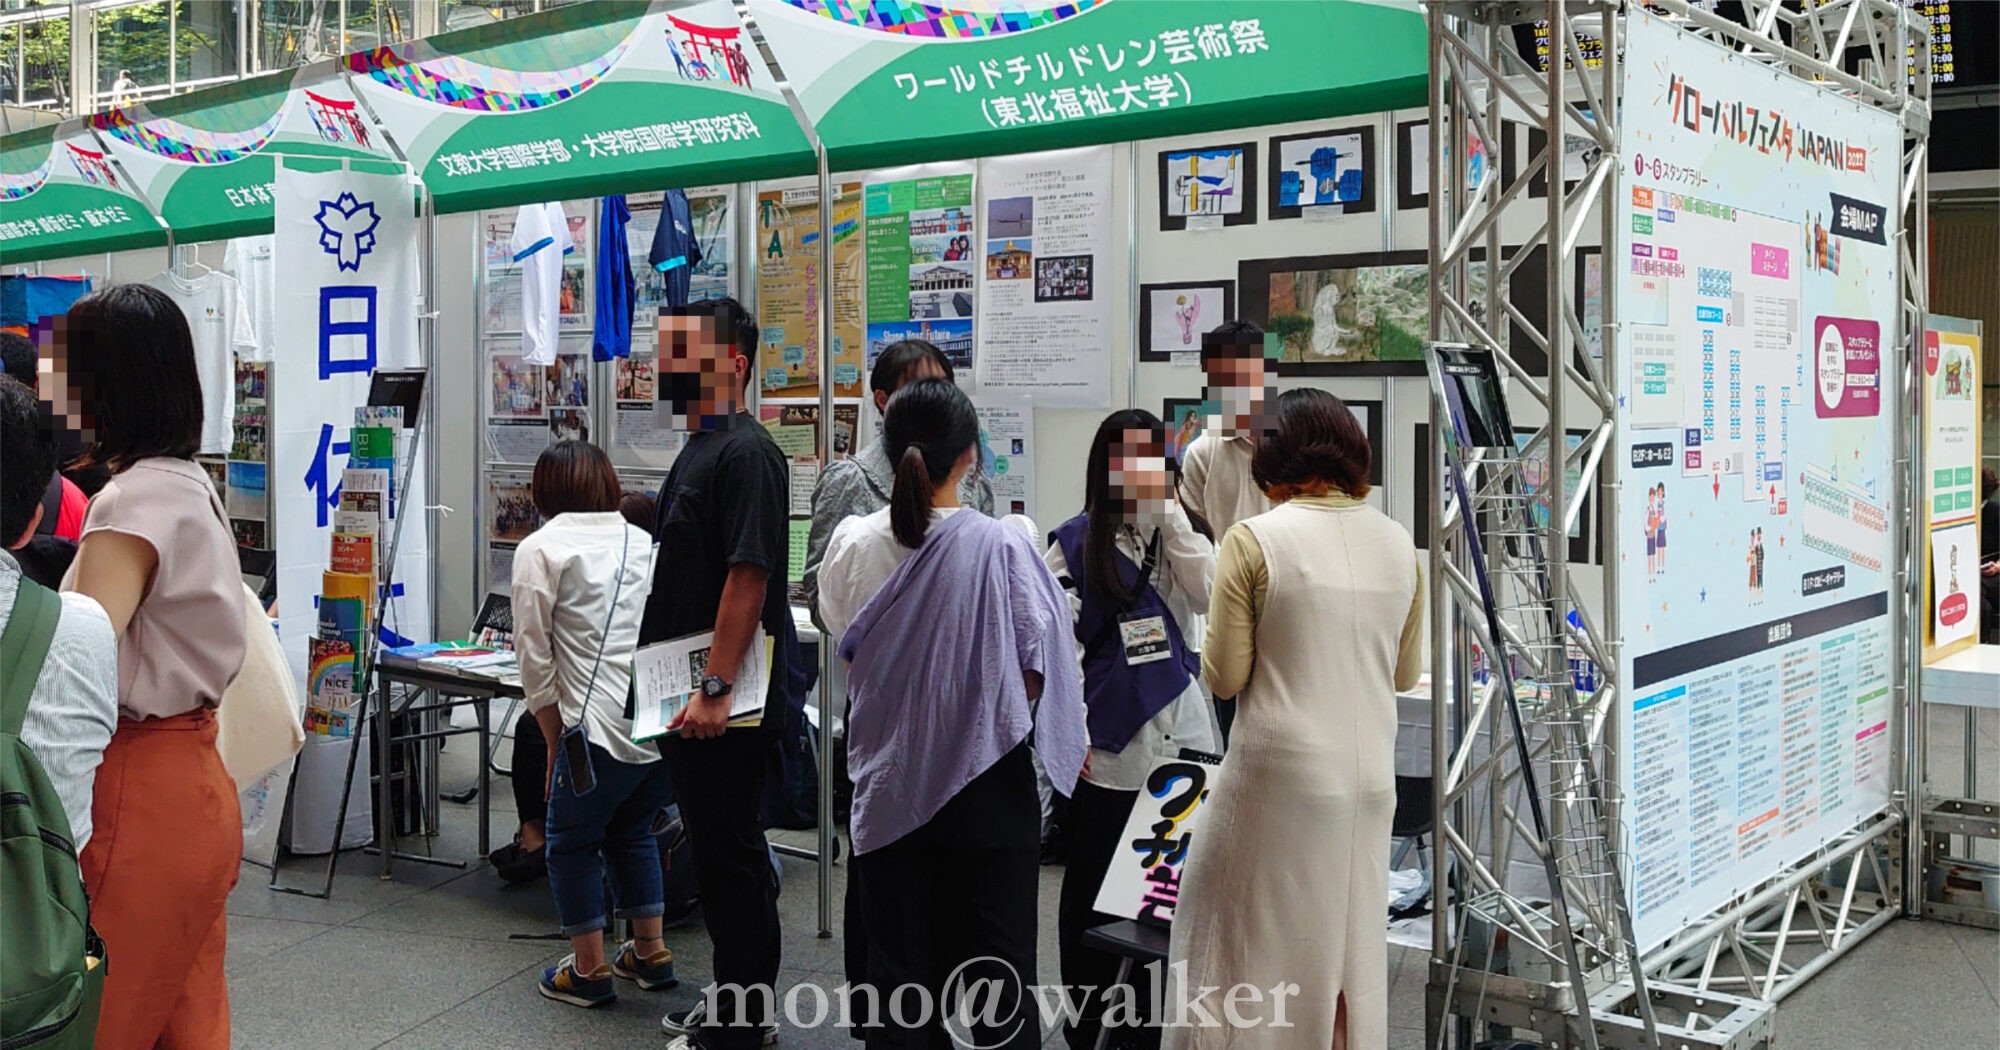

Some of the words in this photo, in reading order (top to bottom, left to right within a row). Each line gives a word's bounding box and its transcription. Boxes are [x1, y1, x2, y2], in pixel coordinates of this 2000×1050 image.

[894, 18, 1270, 101] ワールドチルドレン芸術祭
[981, 71, 1193, 129] (東北福祉大学)
[1668, 71, 1793, 163] グローバルフェスタ
[1798, 133, 1844, 171] JAPAN
[1847, 149, 1866, 171] 2022
[437, 111, 761, 178] 文教大学国際学部・大学院国際学研究科
[1840, 204, 1878, 234] 会場MAP
